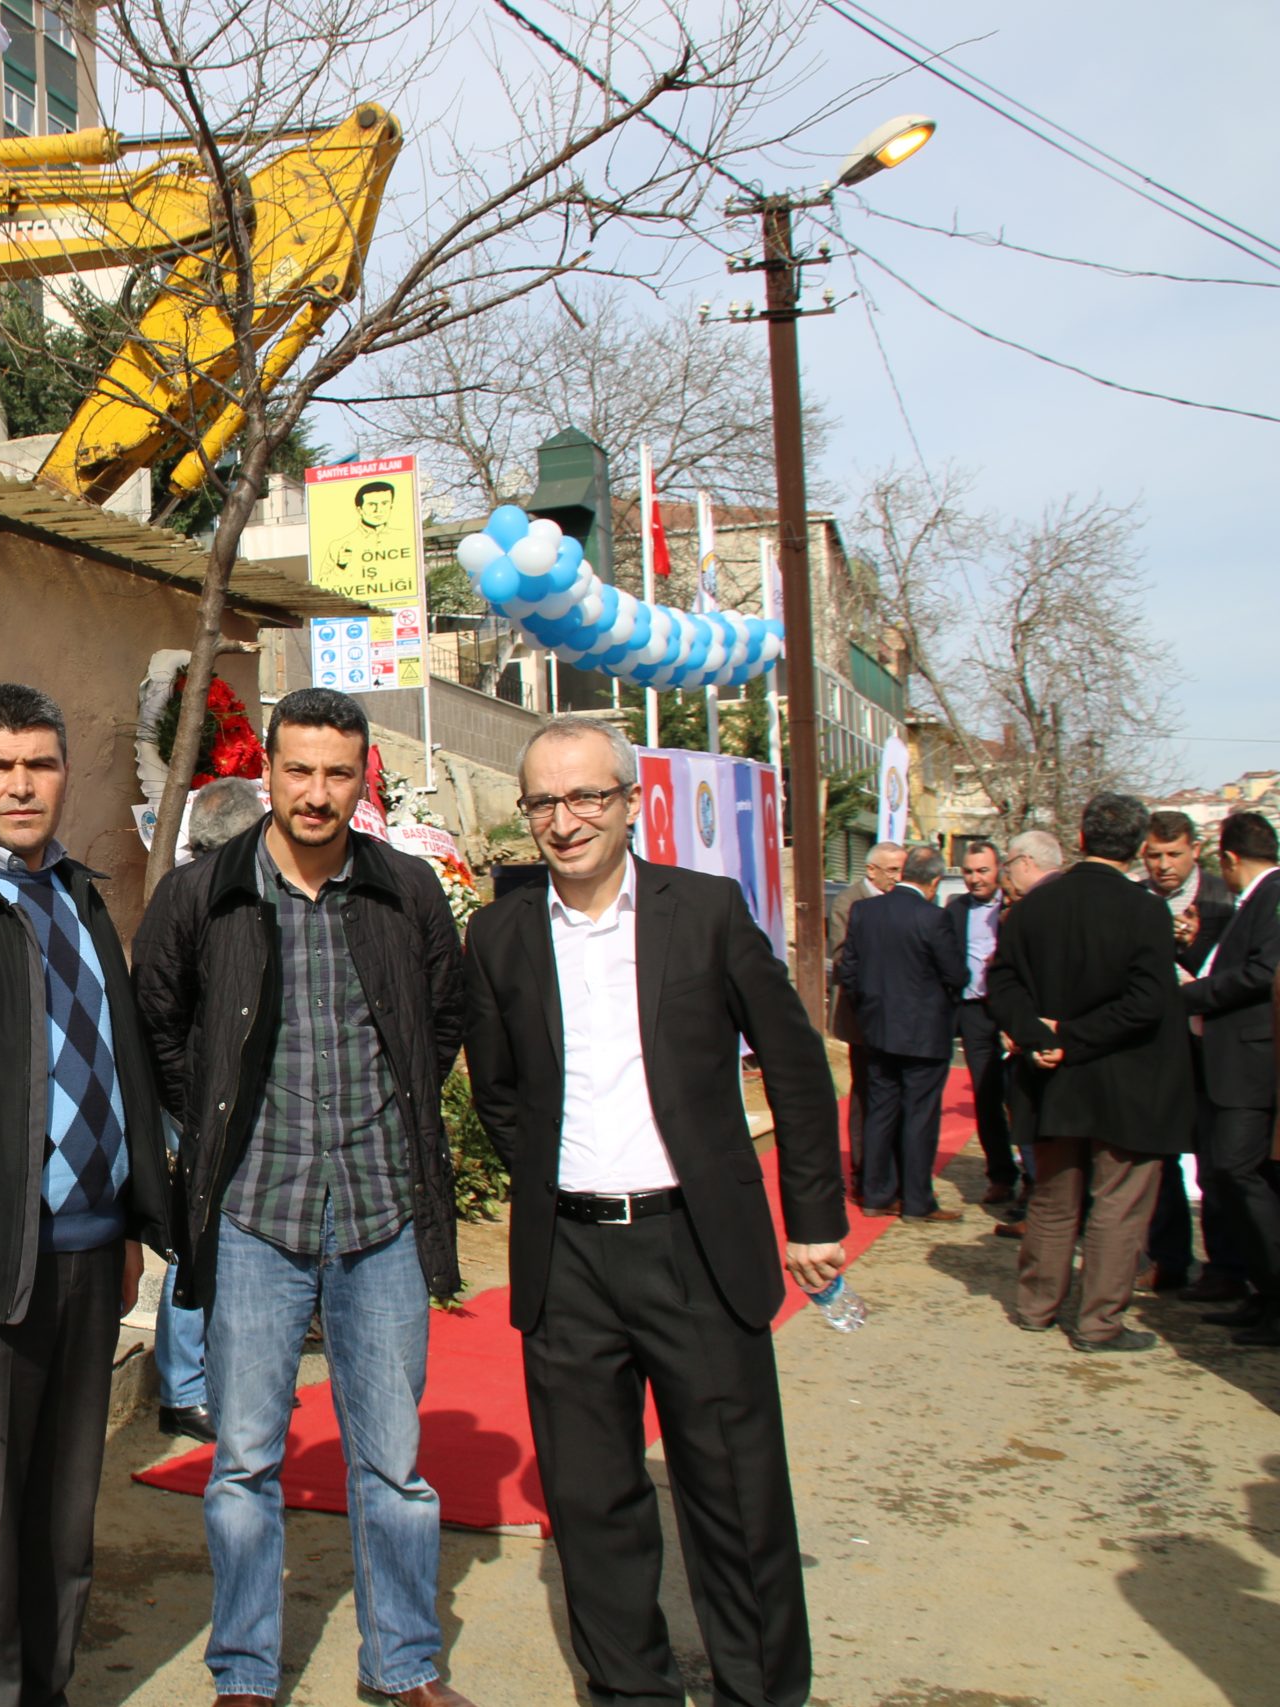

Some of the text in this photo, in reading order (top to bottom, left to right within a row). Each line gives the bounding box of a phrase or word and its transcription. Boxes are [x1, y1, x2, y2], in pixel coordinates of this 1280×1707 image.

[316, 459, 402, 481] ŞANTİYE İNŞAAT ALANI
[361, 547, 411, 562] ÖNCE
[361, 565, 377, 580] İŞ
[402, 829, 428, 840] BASS
